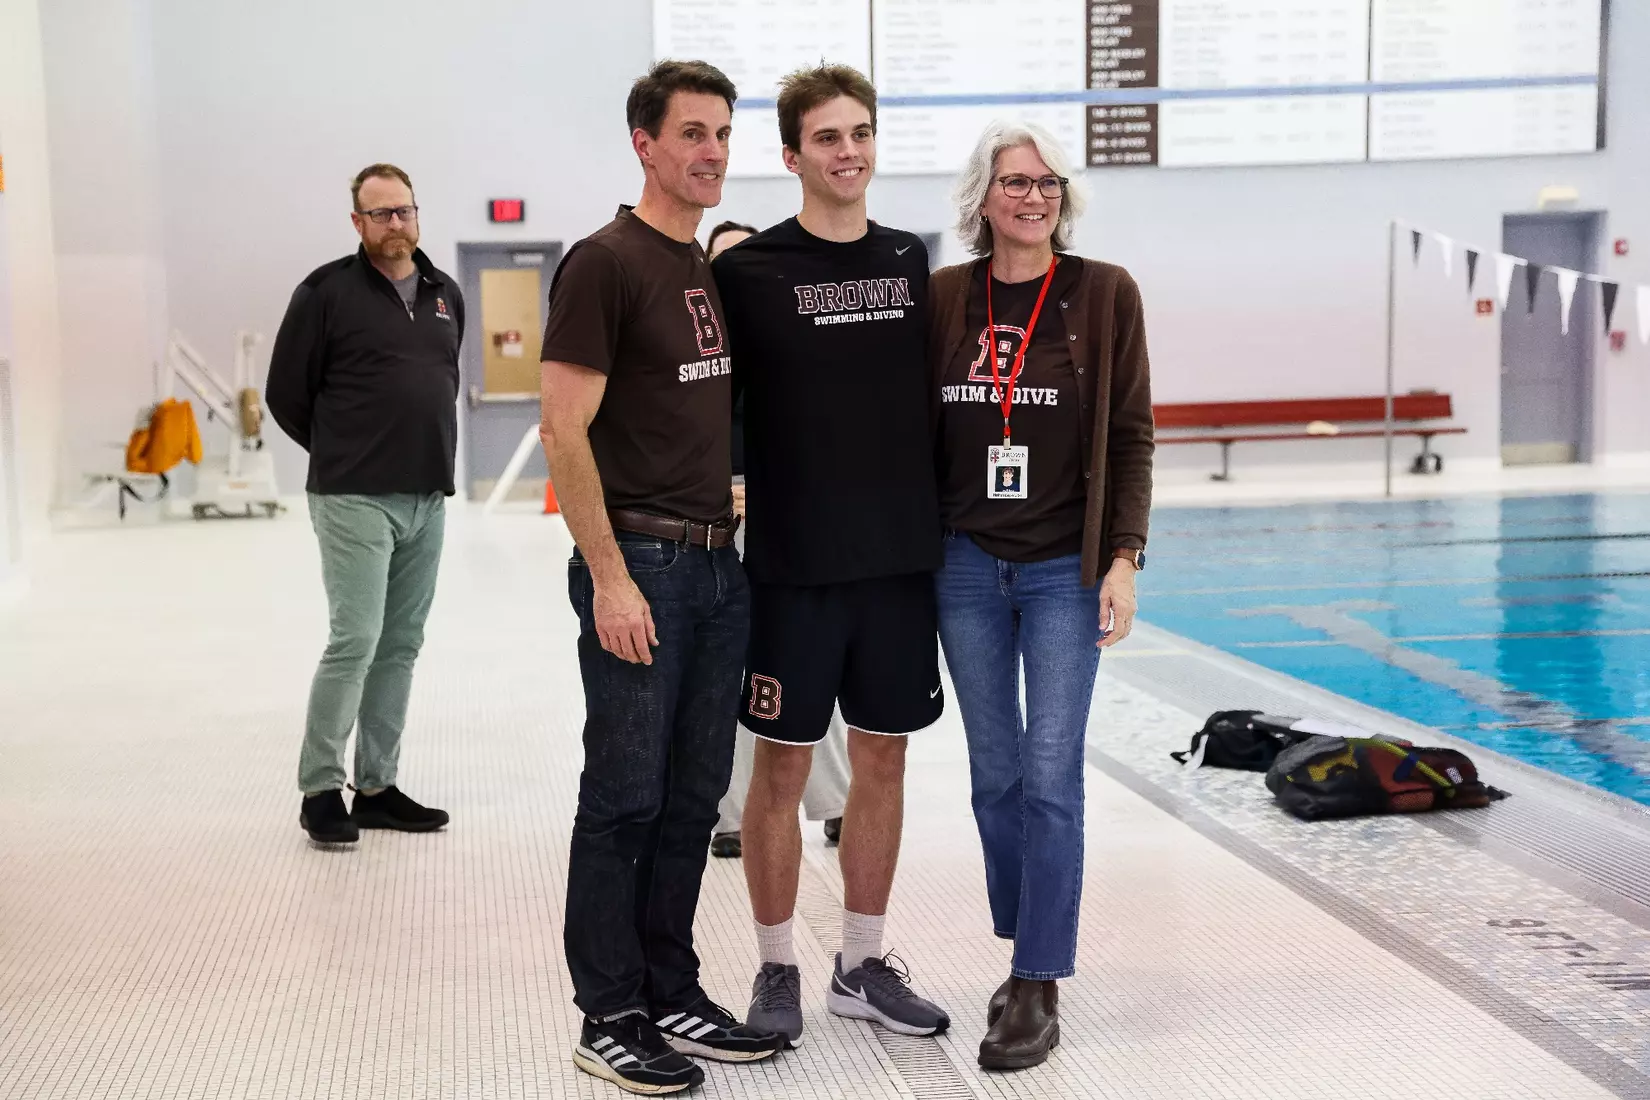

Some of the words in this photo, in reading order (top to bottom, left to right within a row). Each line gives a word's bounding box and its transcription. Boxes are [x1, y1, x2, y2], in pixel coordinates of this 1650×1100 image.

[794, 278, 912, 314] BROWN
[684, 288, 723, 357] B
[814, 313, 865, 325] SWIMMING
[866, 312, 873, 320] &
[873, 309, 904, 320] DIVING
[679, 360, 711, 382] SWIM
[711, 358, 720, 377] &
[967, 325, 1029, 383] B
[941, 385, 986, 403] SWIM
[1010, 387, 1058, 405] DIVE
[748, 673, 782, 720] B
